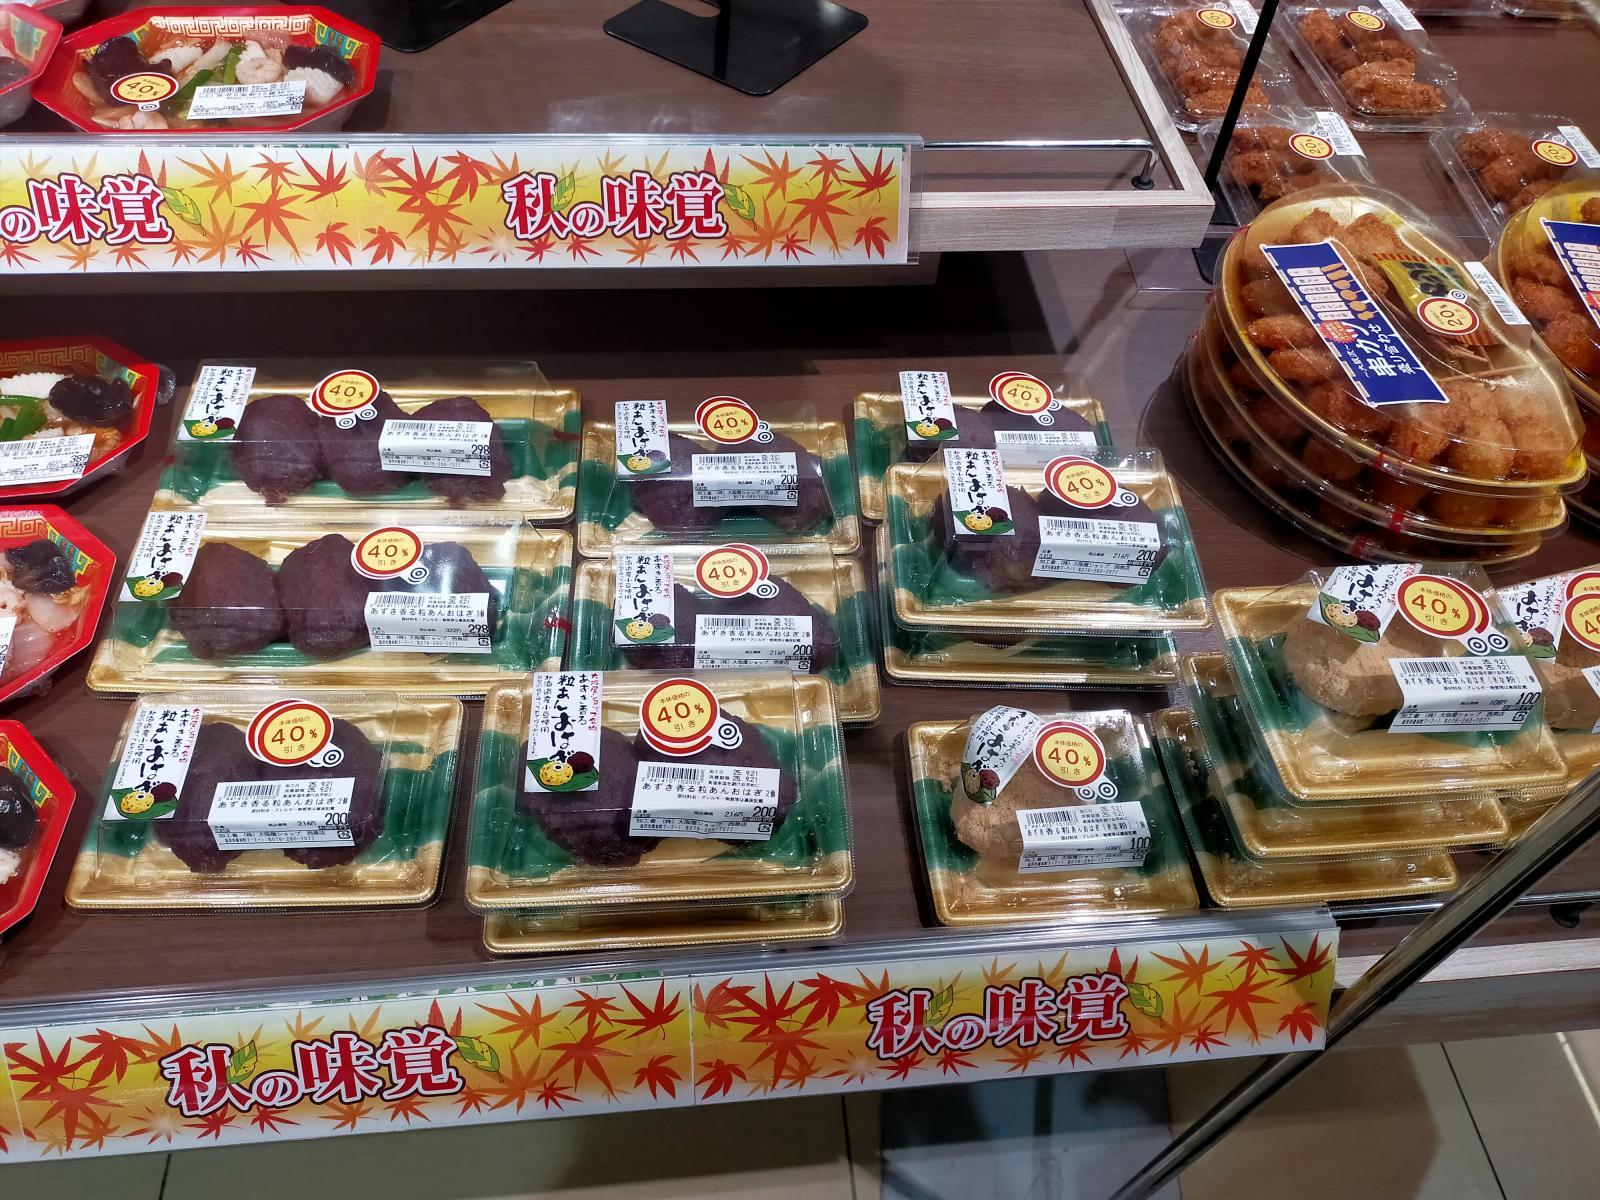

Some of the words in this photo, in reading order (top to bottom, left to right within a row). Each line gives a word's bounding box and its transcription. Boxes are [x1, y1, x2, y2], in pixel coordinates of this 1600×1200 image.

[126, 81, 159, 97] 40%
[502, 171, 728, 241] 秋の味覚
[1439, 303, 1464, 327] 20%
[1341, 321, 1397, 377] 串カツ
[1368, 323, 1416, 375] 盛り合わせ
[329, 385, 365, 399] 40%
[1007, 388, 1041, 404] 40%
[631, 402, 650, 461] 粒あんおはぎ
[713, 417, 749, 430] 40%
[471, 445, 490, 455] 298
[781, 474, 798, 485] 200
[965, 451, 990, 519] 粒あんおはぎ
[1066, 477, 1106, 495] 40%
[146, 514, 183, 585] 粒あんおはぎ
[367, 544, 409, 558] 40%
[1136, 550, 1157, 562] 200
[708, 565, 747, 581] 40%
[633, 555, 653, 627] 粒あんおはぎ
[1411, 594, 1461, 619] 40%
[468, 624, 489, 634] 298
[793, 645, 812, 656] 200
[660, 691, 691, 704] 本体価格の
[1514, 692, 1541, 705] 100
[657, 702, 704, 723] 40%
[548, 674, 576, 769] 粒あんおはぎ
[674, 720, 696, 732] 引き
[271, 725, 318, 745] 40%
[133, 709, 178, 798] 粒あんおはぎ
[1047, 747, 1092, 767] 40%
[1060, 766, 1081, 776] 引き
[642, 783, 763, 797] あずき香る粒あんおはぎ
[324, 812, 349, 825] 200
[752, 806, 776, 818] 200
[1129, 837, 1150, 849] 100
[866, 972, 1131, 1061] 秋の味覚
[158, 1026, 465, 1118] 秋の味覚
